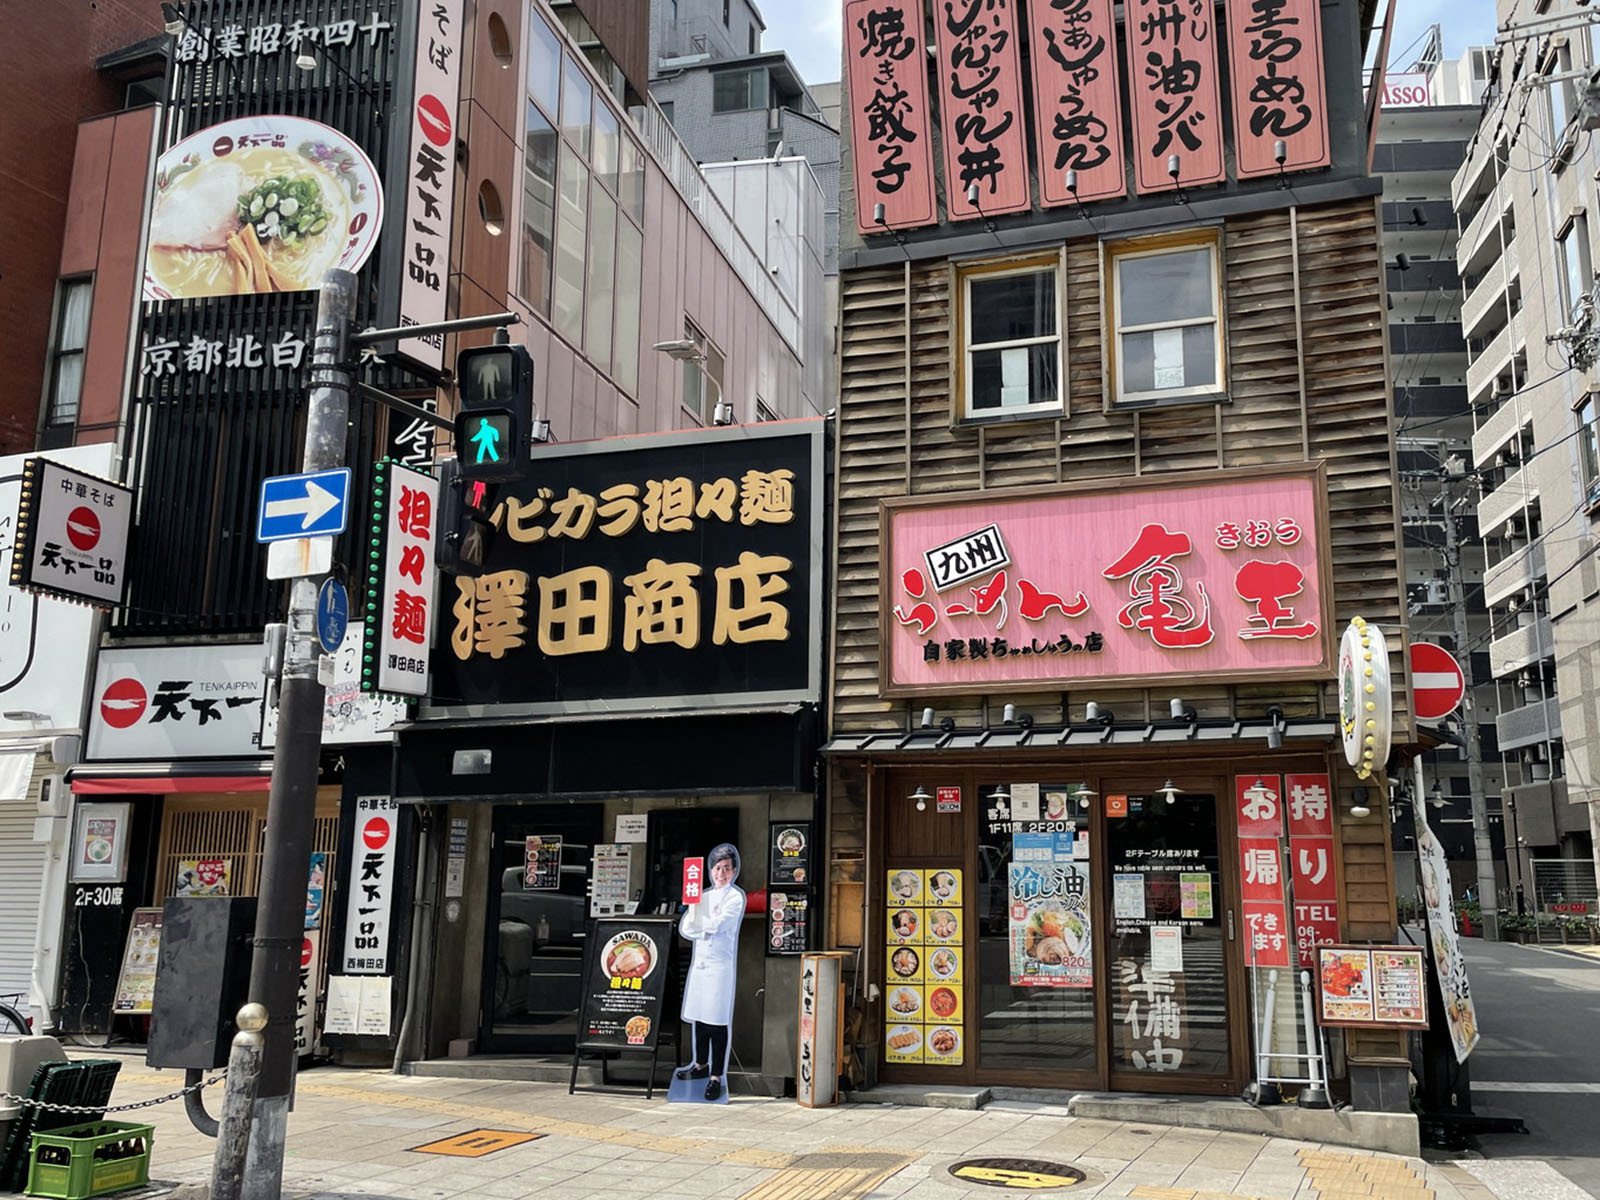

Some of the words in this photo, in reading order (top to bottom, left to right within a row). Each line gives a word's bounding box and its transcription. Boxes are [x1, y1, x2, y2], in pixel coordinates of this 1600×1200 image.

[175, 11, 391, 62] 創業昭和四十
[429, 3, 453, 75] そば
[857, 7, 917, 194] 焼き餃子
[1140, 0, 1205, 157] 州油ソバ
[408, 142, 447, 292] 天下一品
[401, 314, 442, 351] 西田店
[60, 477, 117, 508] 中華そば
[489, 469, 796, 543] ビカラ担々麺
[1214, 517, 1302, 550] きおう
[40, 541, 116, 586] 天下一品
[938, 534, 998, 581] 九州
[450, 551, 793, 661] 澤田商店
[893, 569, 1091, 635] らーめん
[388, 653, 425, 675] 澤田商店
[199, 681, 258, 693] TENKAIPPIN
[75, 886, 124, 906] 2F30席
[354, 853, 386, 950] 天下一品
[685, 864, 700, 898] 合格
[1296, 906, 1336, 921] TEL
[612, 932, 652, 948] SAWADA
[347, 958, 385, 969] 西梅田店
